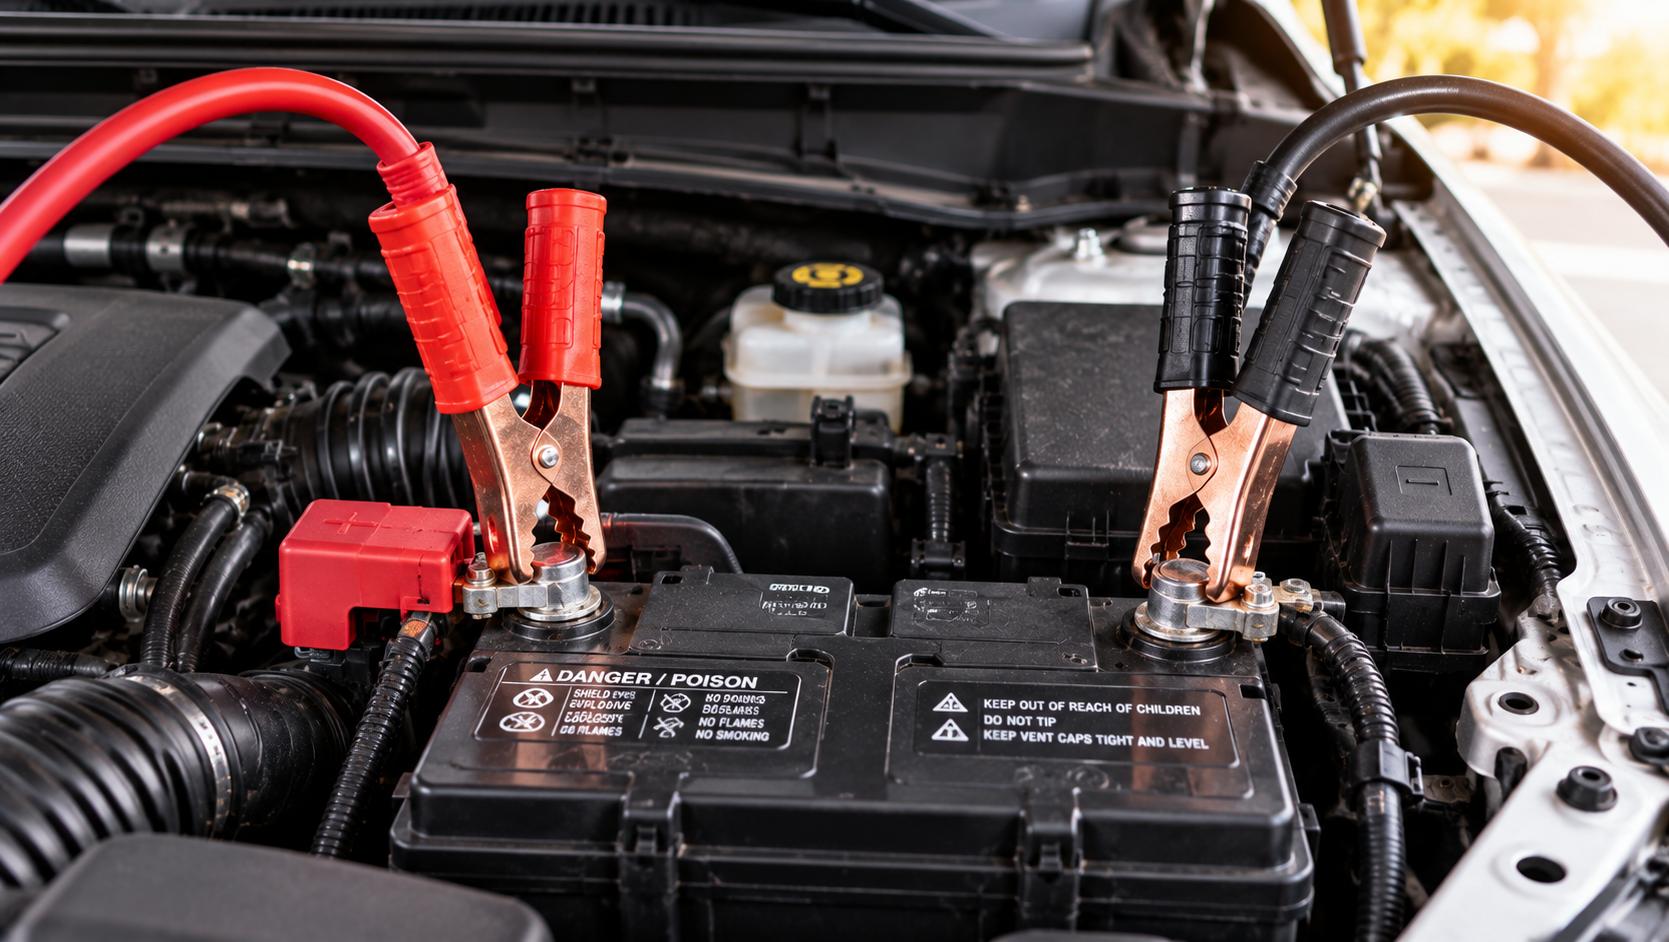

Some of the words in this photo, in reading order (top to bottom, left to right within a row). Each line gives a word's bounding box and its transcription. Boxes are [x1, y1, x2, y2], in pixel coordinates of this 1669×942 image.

[556, 669, 652, 685] DANGER
[655, 673, 667, 686] /
[670, 673, 758, 689] POISON
[573, 688, 611, 699] SHIELD
[983, 699, 1016, 710] KEEP
[1019, 700, 1045, 711] OUT
[1048, 701, 1065, 711] OF
[1068, 702, 1112, 712] REACH
[1115, 703, 1133, 714] OF
[1136, 704, 1201, 716] CHILDREN
[698, 717, 716, 727] NO
[719, 717, 765, 729] FLAMES
[983, 715, 1003, 725] DO
[1006, 716, 1033, 726] NOT
[1036, 716, 1057, 727] TIP
[695, 729, 713, 739] NO
[715, 729, 770, 742] SMOKING
[983, 729, 1017, 741] KEEP
[1020, 731, 1054, 743] VENT
[1057, 733, 1093, 745] CAPS
[1095, 734, 1134, 746] TIGHT
[1137, 737, 1166, 748] AND
[1168, 737, 1210, 750] LEVEL
